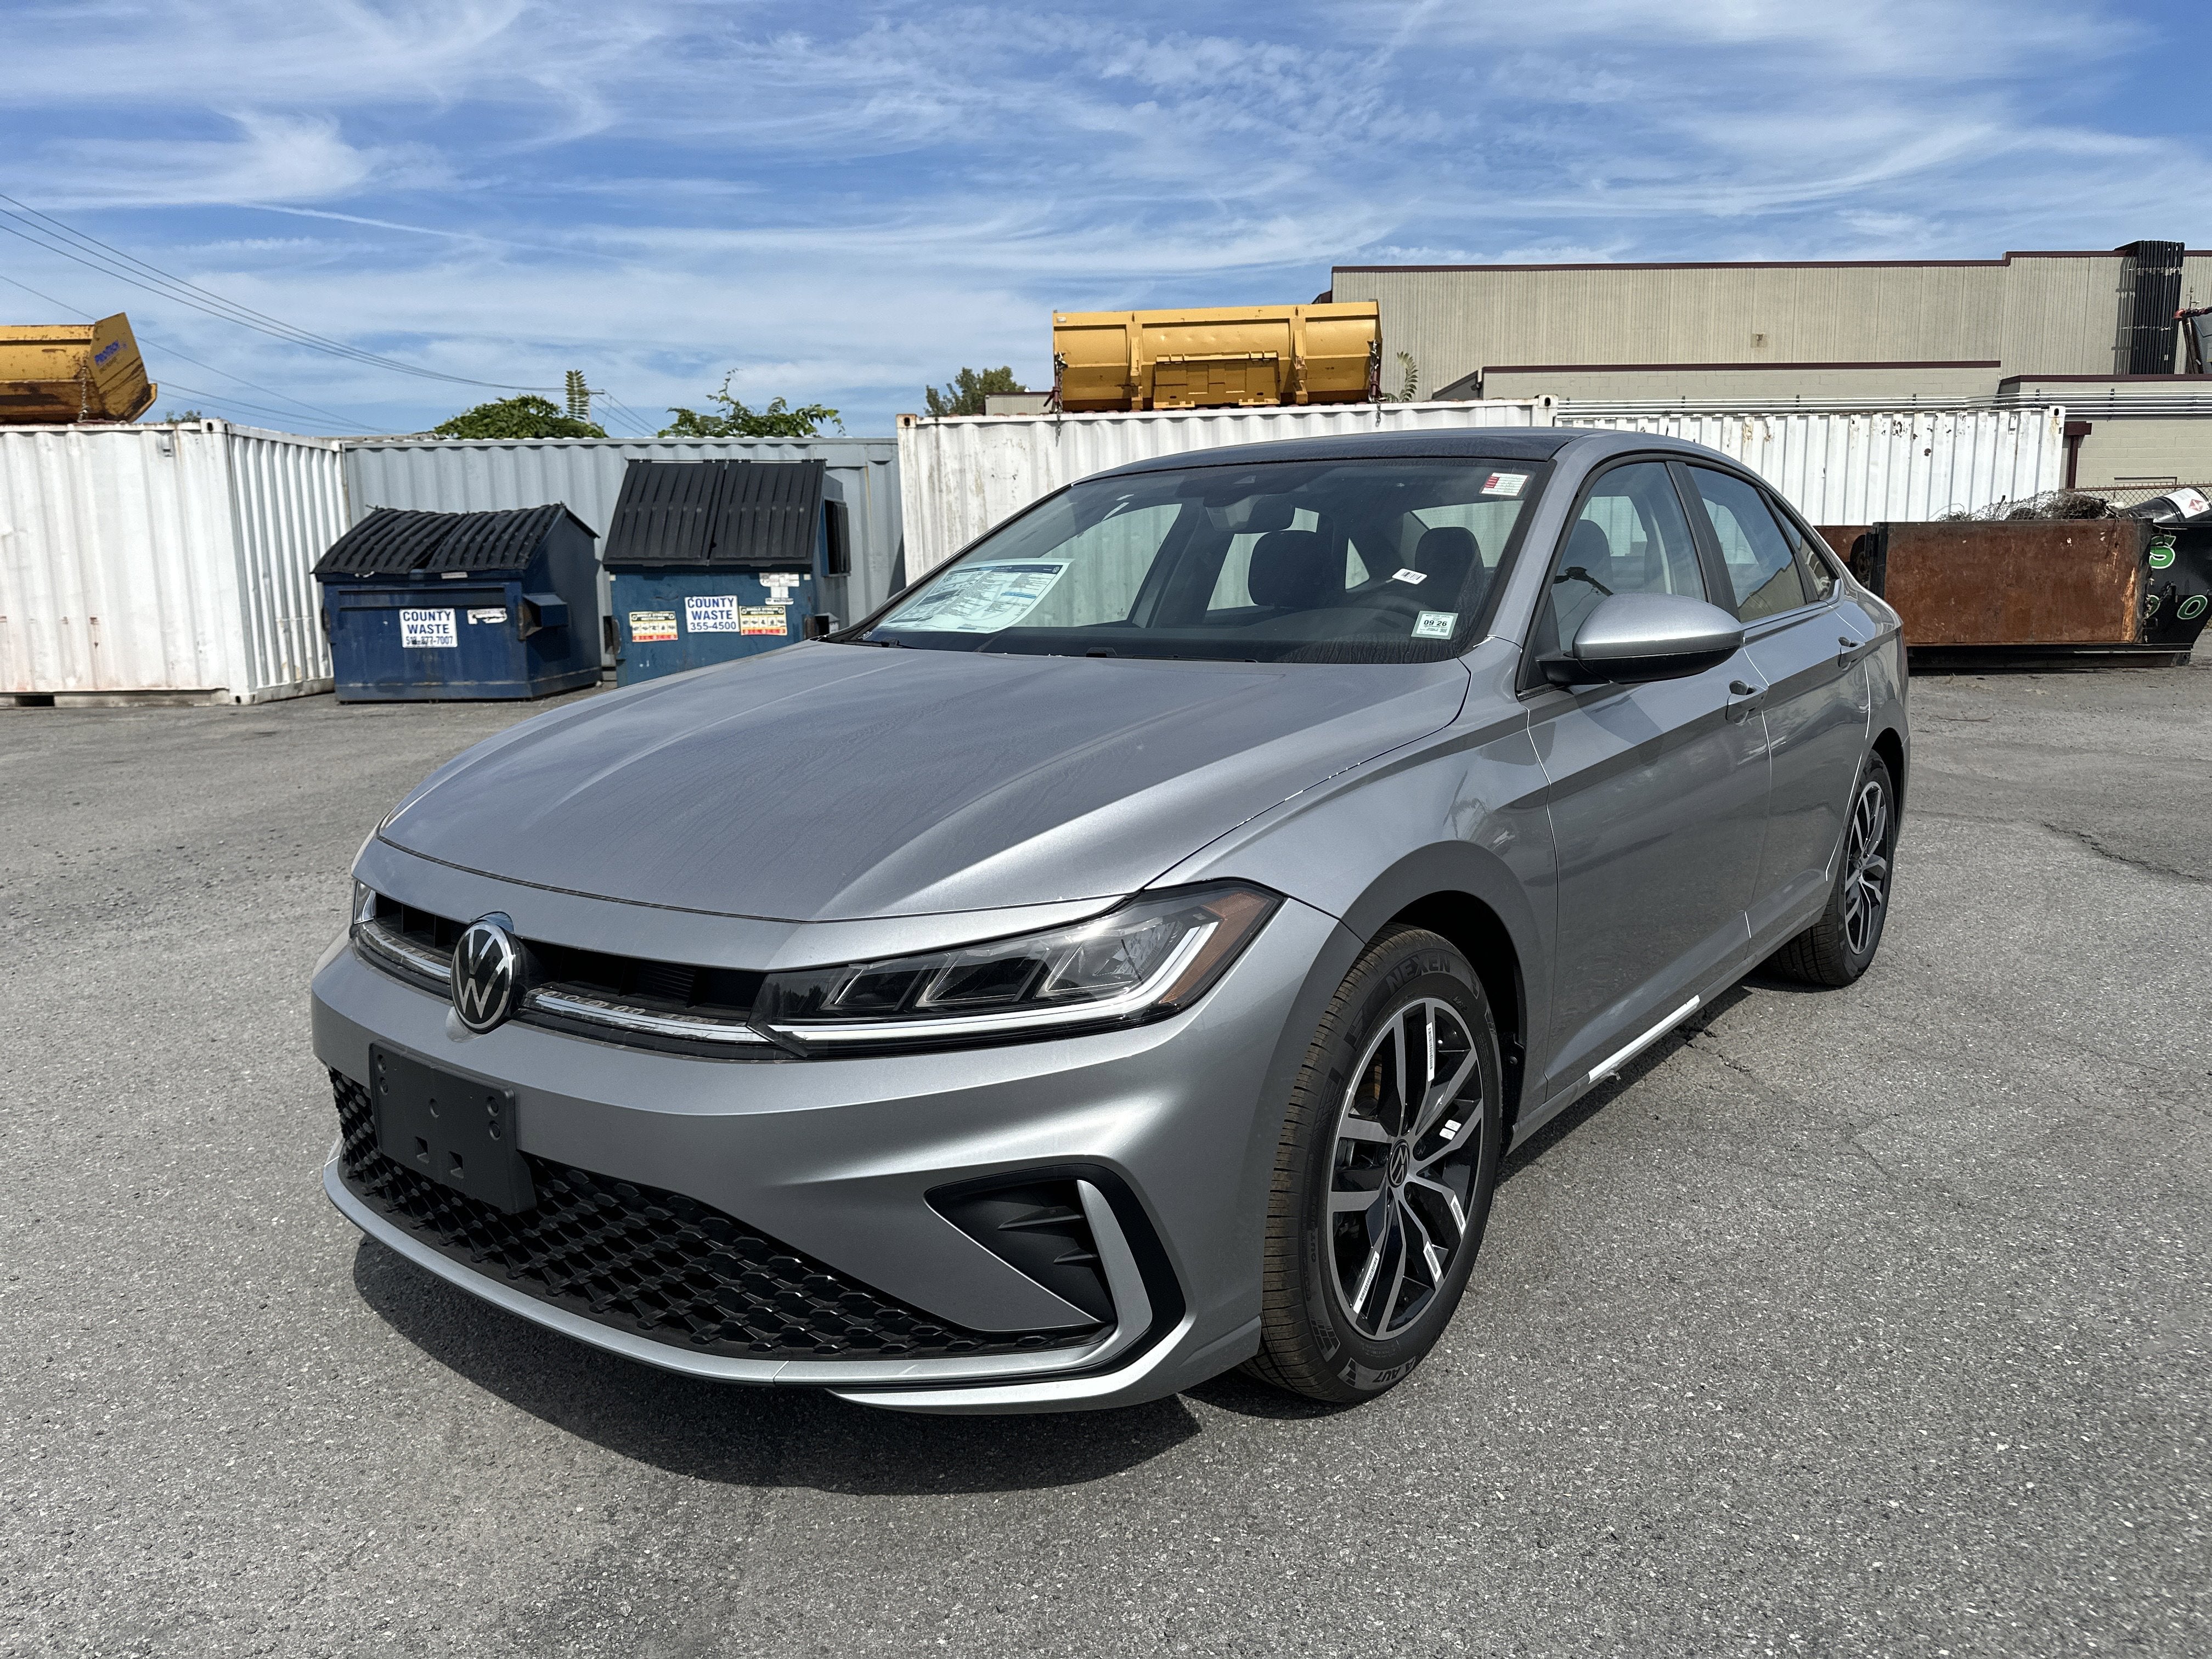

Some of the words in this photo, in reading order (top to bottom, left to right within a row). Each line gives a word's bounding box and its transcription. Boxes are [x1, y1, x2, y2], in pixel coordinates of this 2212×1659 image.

[687, 598, 733, 608] COUNTY
[403, 611, 451, 621] COUNTY
[691, 610, 733, 620] WASTE
[407, 624, 450, 634] WASTE
[690, 621, 736, 630] 355-4500
[453, 927, 510, 1024] VW
[1386, 953, 1451, 995] NEXEN
[1372, 1367, 1401, 1383] AU7
